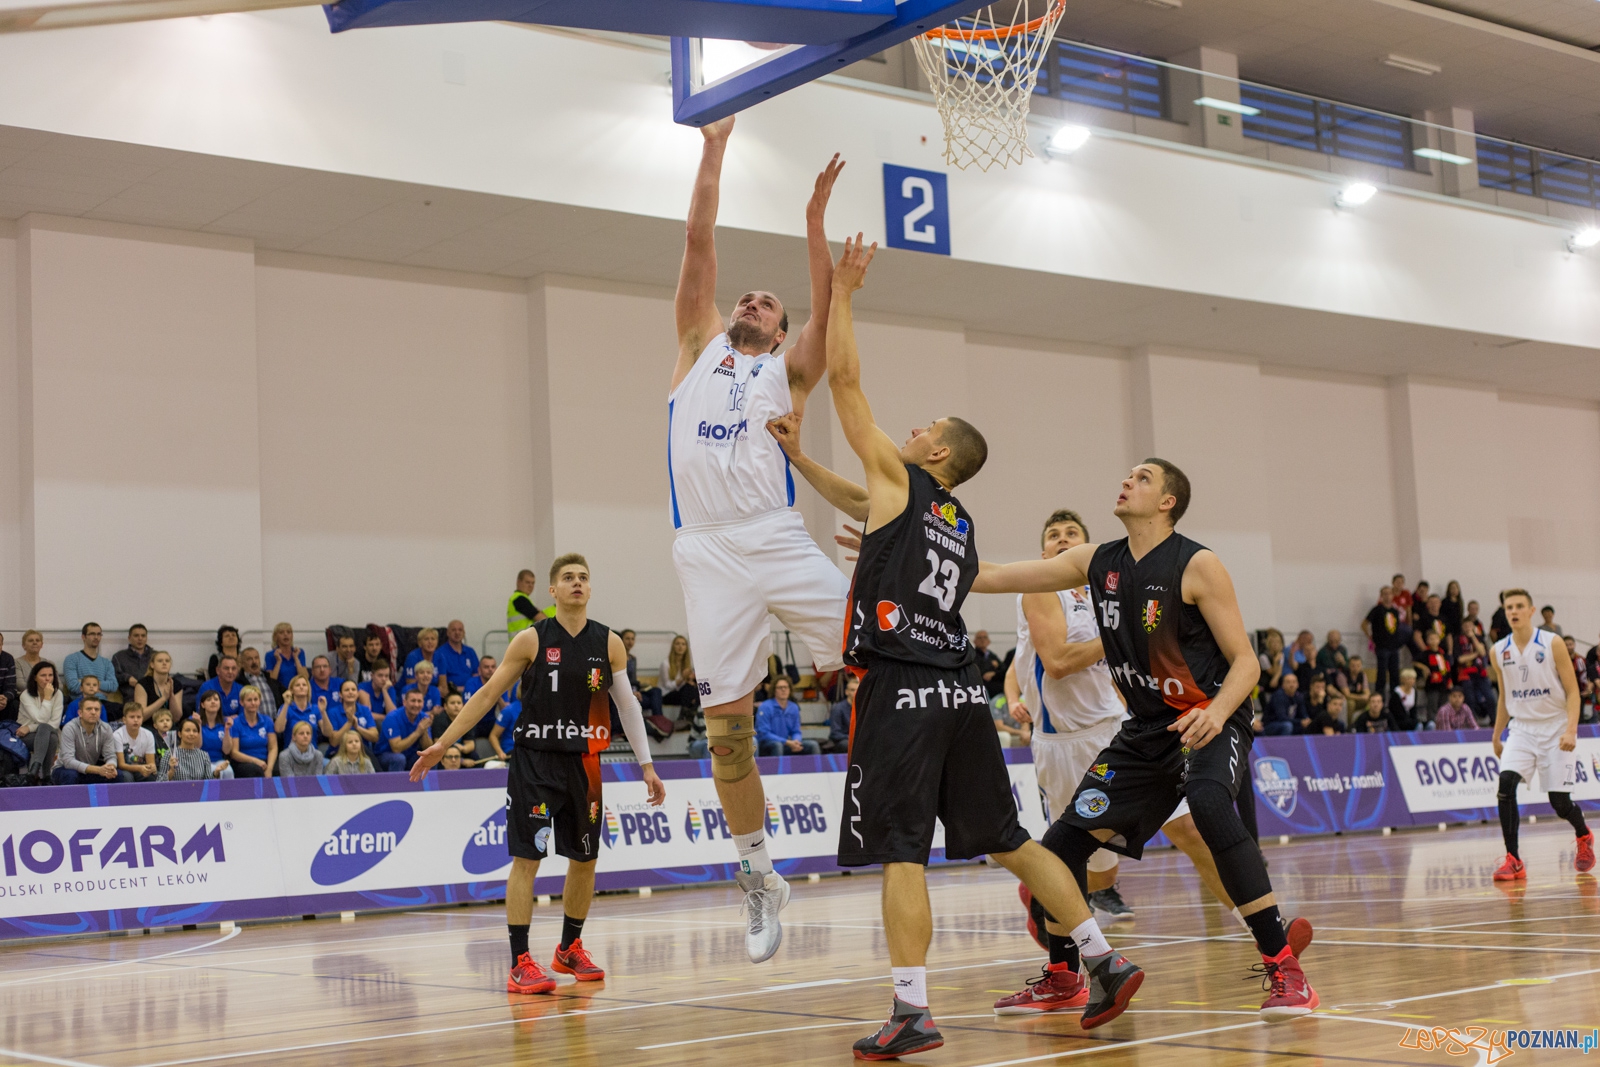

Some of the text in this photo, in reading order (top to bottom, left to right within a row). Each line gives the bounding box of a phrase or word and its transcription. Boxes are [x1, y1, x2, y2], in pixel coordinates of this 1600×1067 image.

[901, 176, 936, 244] 2
[918, 547, 960, 612] 23
[1099, 600, 1120, 630] 15
[910, 628, 947, 650] Szkoły
[548, 669, 559, 692] 1
[1518, 664, 1529, 683] 7
[1303, 771, 1385, 793] Trenuj z nami!
[776, 793, 821, 803] fundacja
[620, 811, 672, 846] PBG
[779, 802, 827, 835] PBG
[324, 829, 397, 857] atrem
[581, 833, 591, 855] 1
[54, 876, 148, 894] PRODUCENT
[157, 870, 209, 887] LEKÓW
